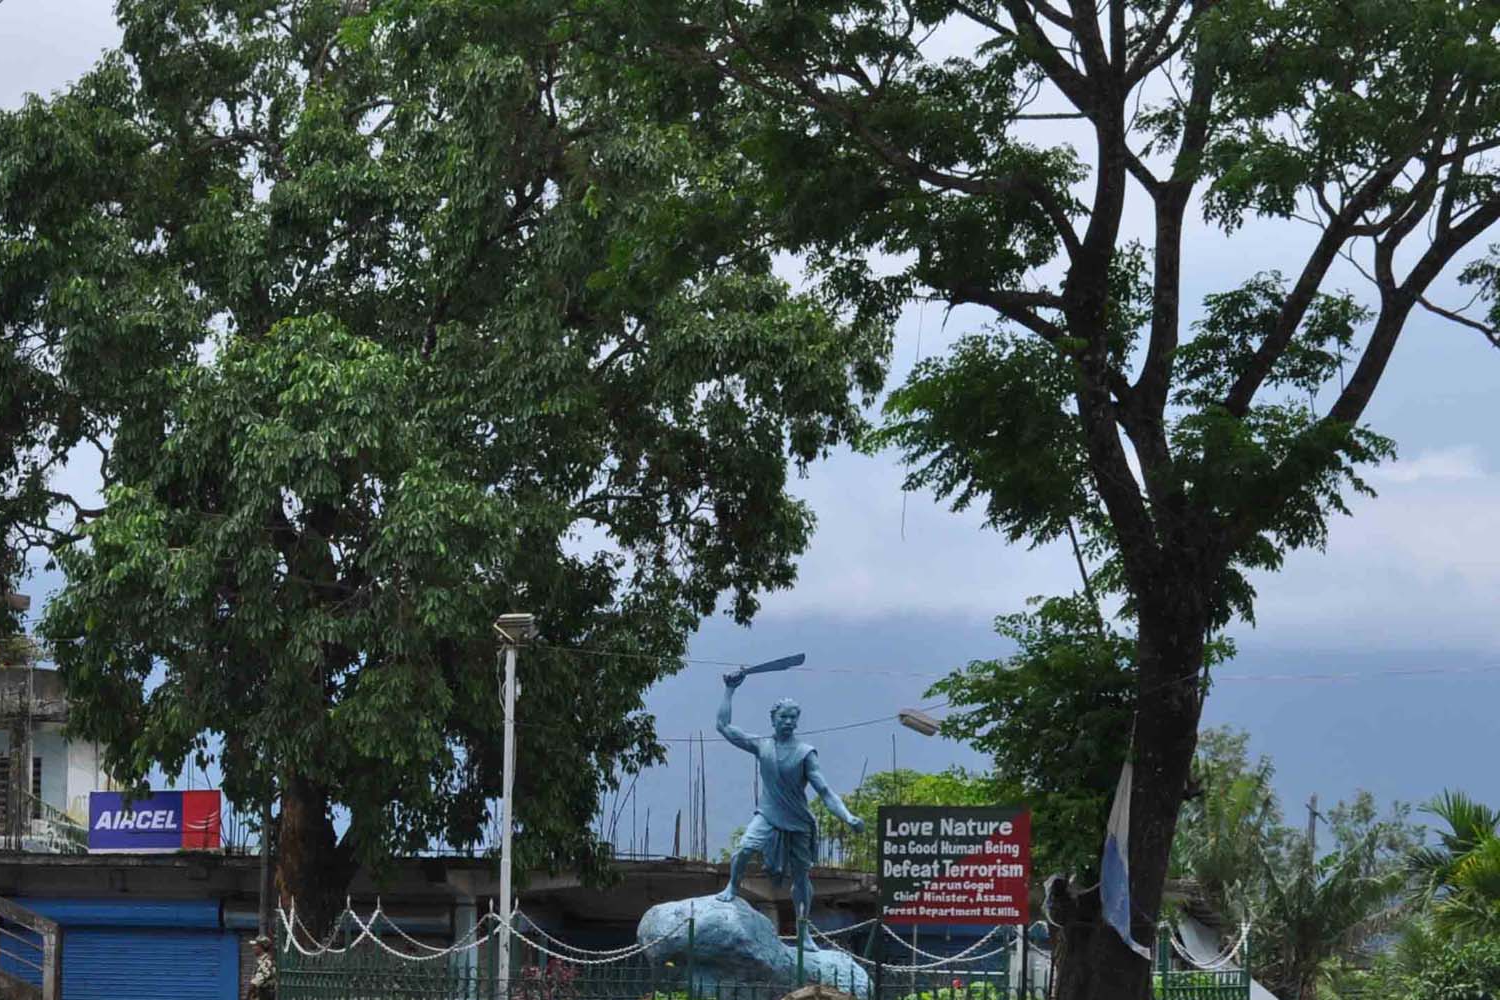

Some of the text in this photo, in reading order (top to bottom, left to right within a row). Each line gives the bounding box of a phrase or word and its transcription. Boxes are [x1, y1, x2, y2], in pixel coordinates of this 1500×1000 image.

[94, 809, 178, 830] AIRCEL
[886, 817, 1013, 837] Love Nature
[883, 840, 1020, 857] Be a Good Human Being
[883, 858, 1024, 878] Defeat Terrorism
[963, 878, 994, 892] Gogoi
[893, 891, 920, 901] Chief
[976, 891, 1012, 902] Assam
[883, 905, 917, 915] Forest
[919, 905, 981, 918] Department
